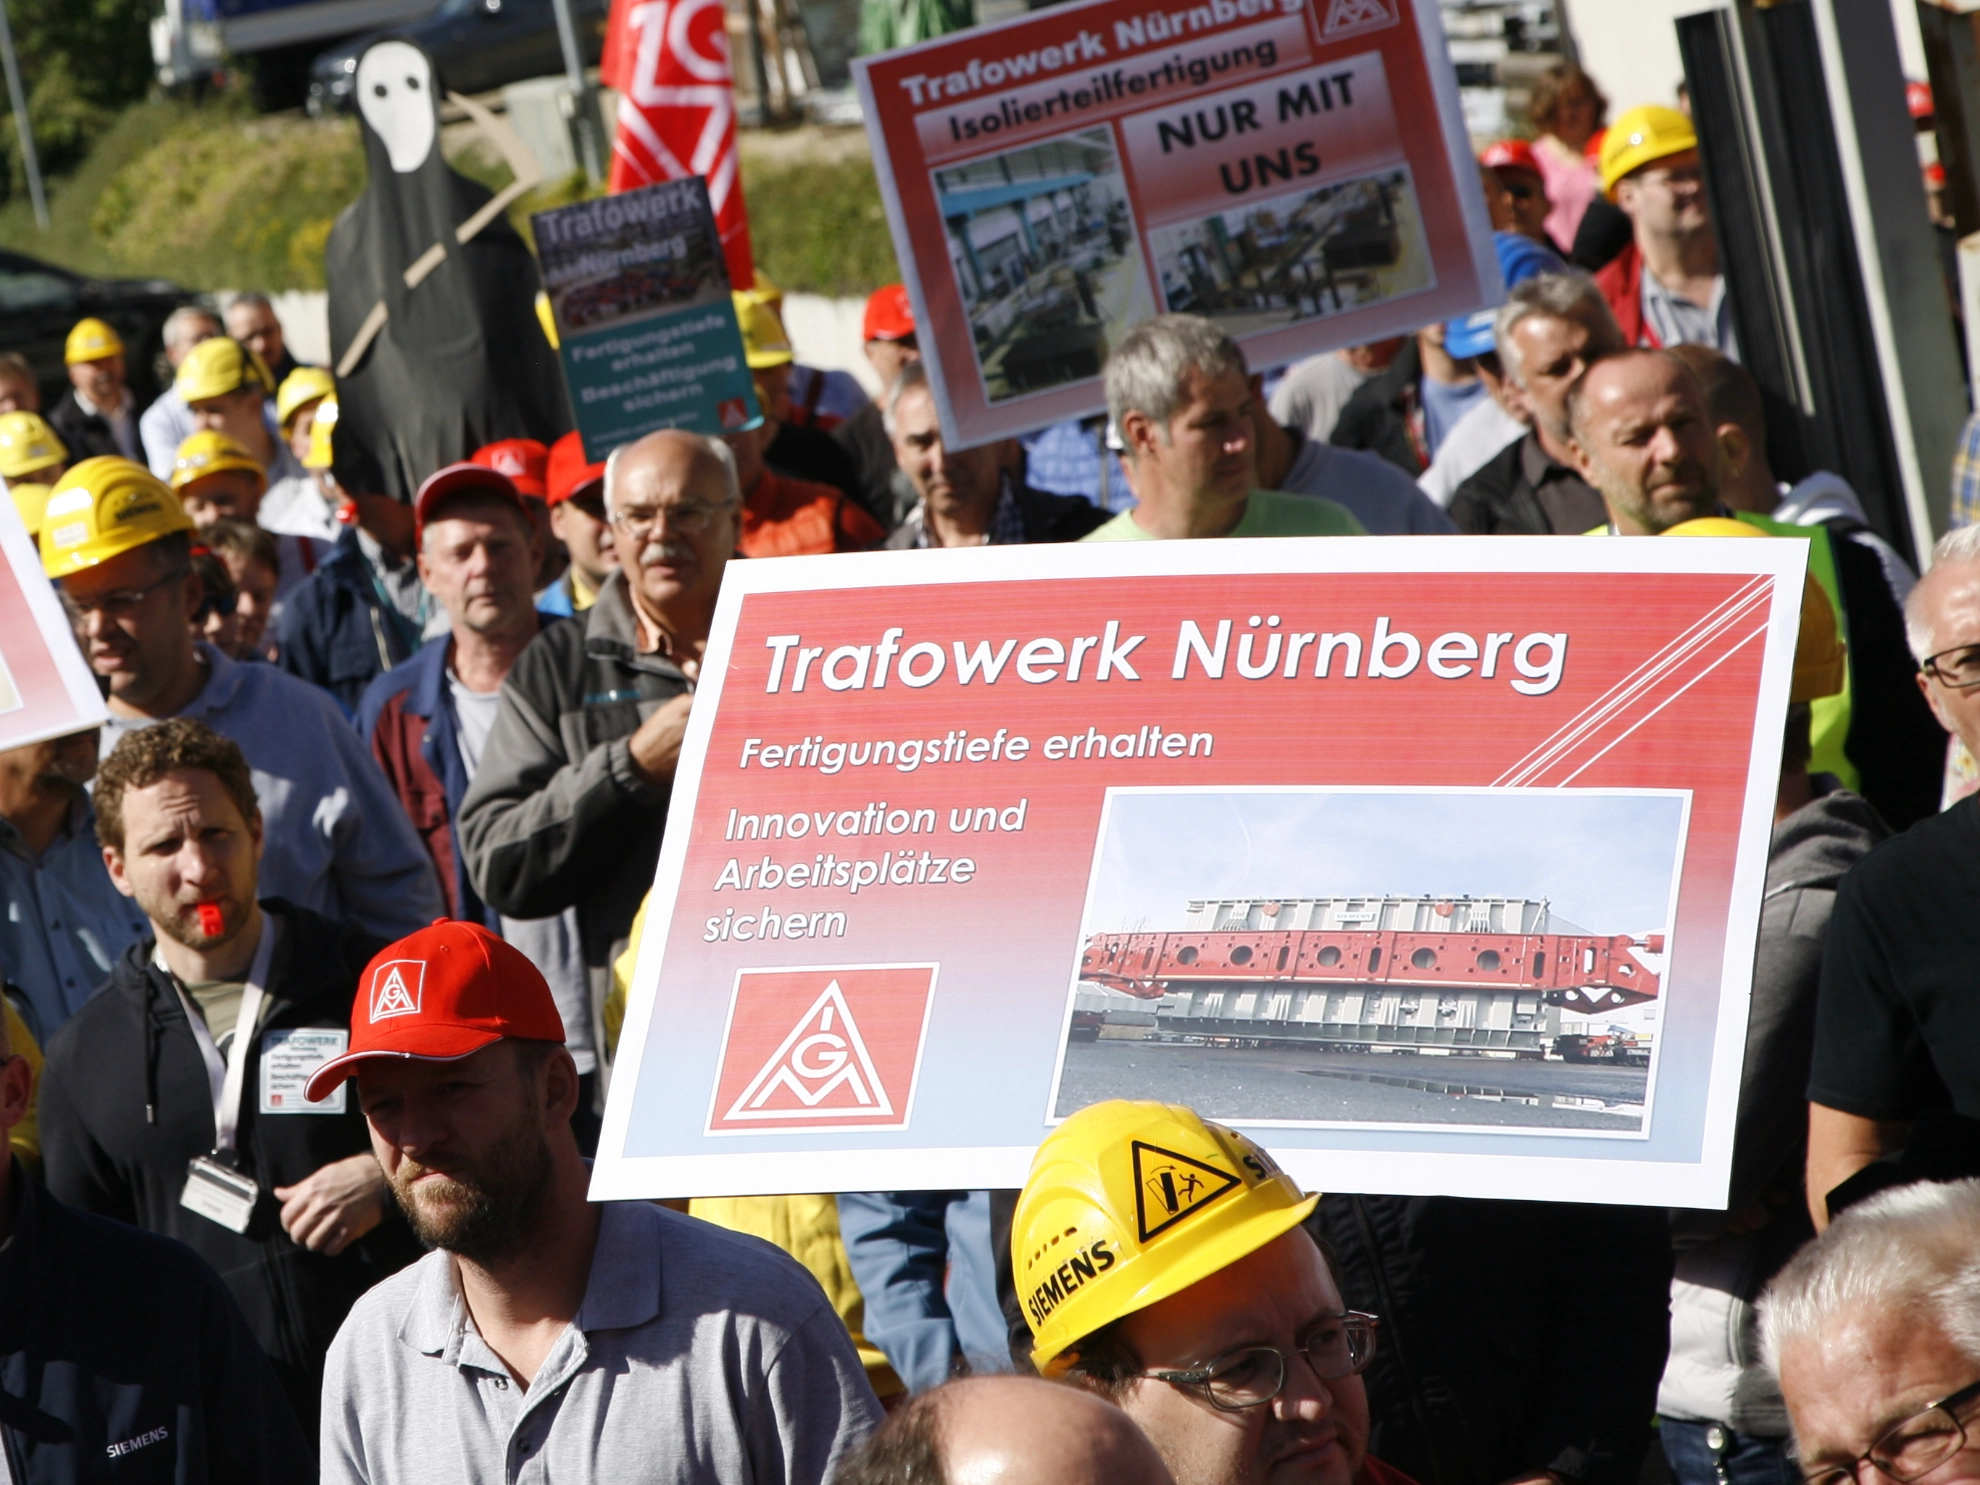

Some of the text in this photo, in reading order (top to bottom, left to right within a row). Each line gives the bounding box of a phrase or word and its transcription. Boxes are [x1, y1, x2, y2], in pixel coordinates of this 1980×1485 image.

[900, 30, 1107, 106] Trafowerk
[950, 39, 1277, 142] Isolierteilfertigung
[1157, 71, 1355, 154] NUR MIT
[1219, 141, 1322, 195] UNS
[538, 177, 703, 243] Trafowerk
[571, 314, 727, 363] Fertigungstiefe
[610, 342, 697, 372] erhalten
[580, 355, 738, 404] Beschäftigung
[621, 382, 705, 413] sichern
[765, 614, 1569, 697] Trafowerk Nürnberg
[739, 725, 1215, 775] Fertigungstiefe erhalten
[724, 797, 1028, 841] Innovation und
[712, 849, 977, 894] Arbeitsplätze
[702, 905, 848, 943] sichern
[1028, 1239, 1115, 1328] SIEMENS
[106, 1426, 169, 1458] SIEMENS
